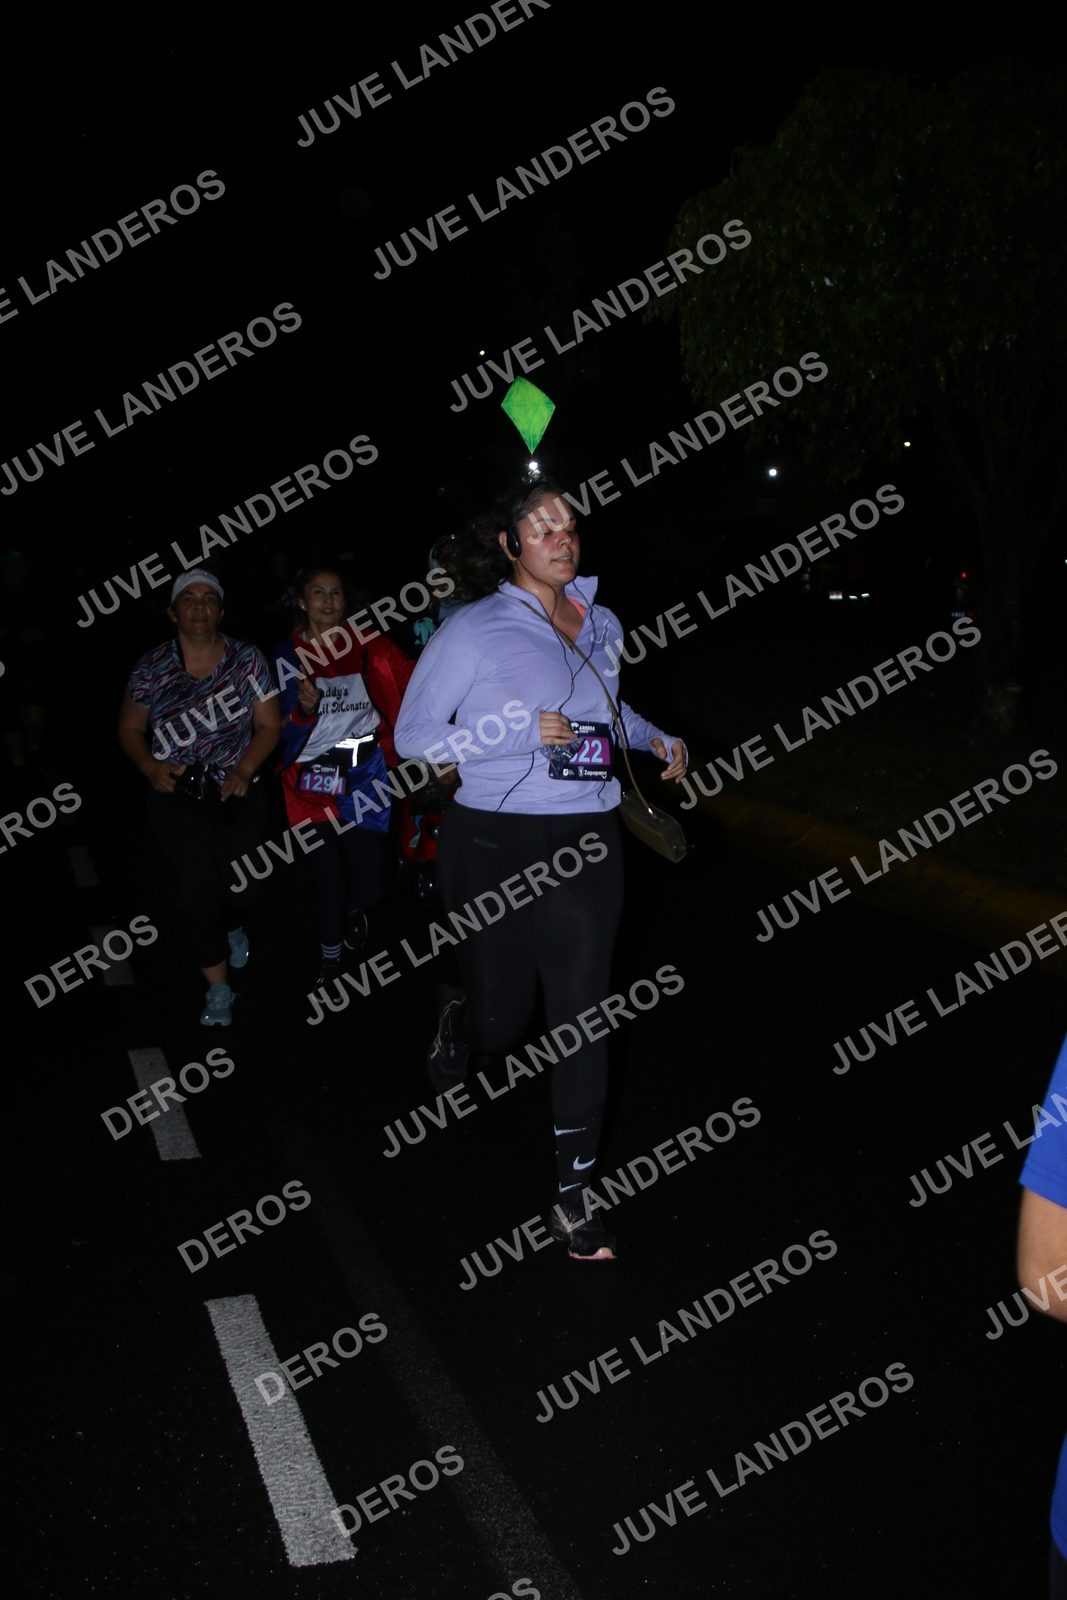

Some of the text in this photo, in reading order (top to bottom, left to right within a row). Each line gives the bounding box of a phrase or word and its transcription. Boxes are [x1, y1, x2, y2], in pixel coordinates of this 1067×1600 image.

[320, 687, 349, 700] addy's
[331, 701, 369, 713] Monster
[569, 739, 603, 763] 22
